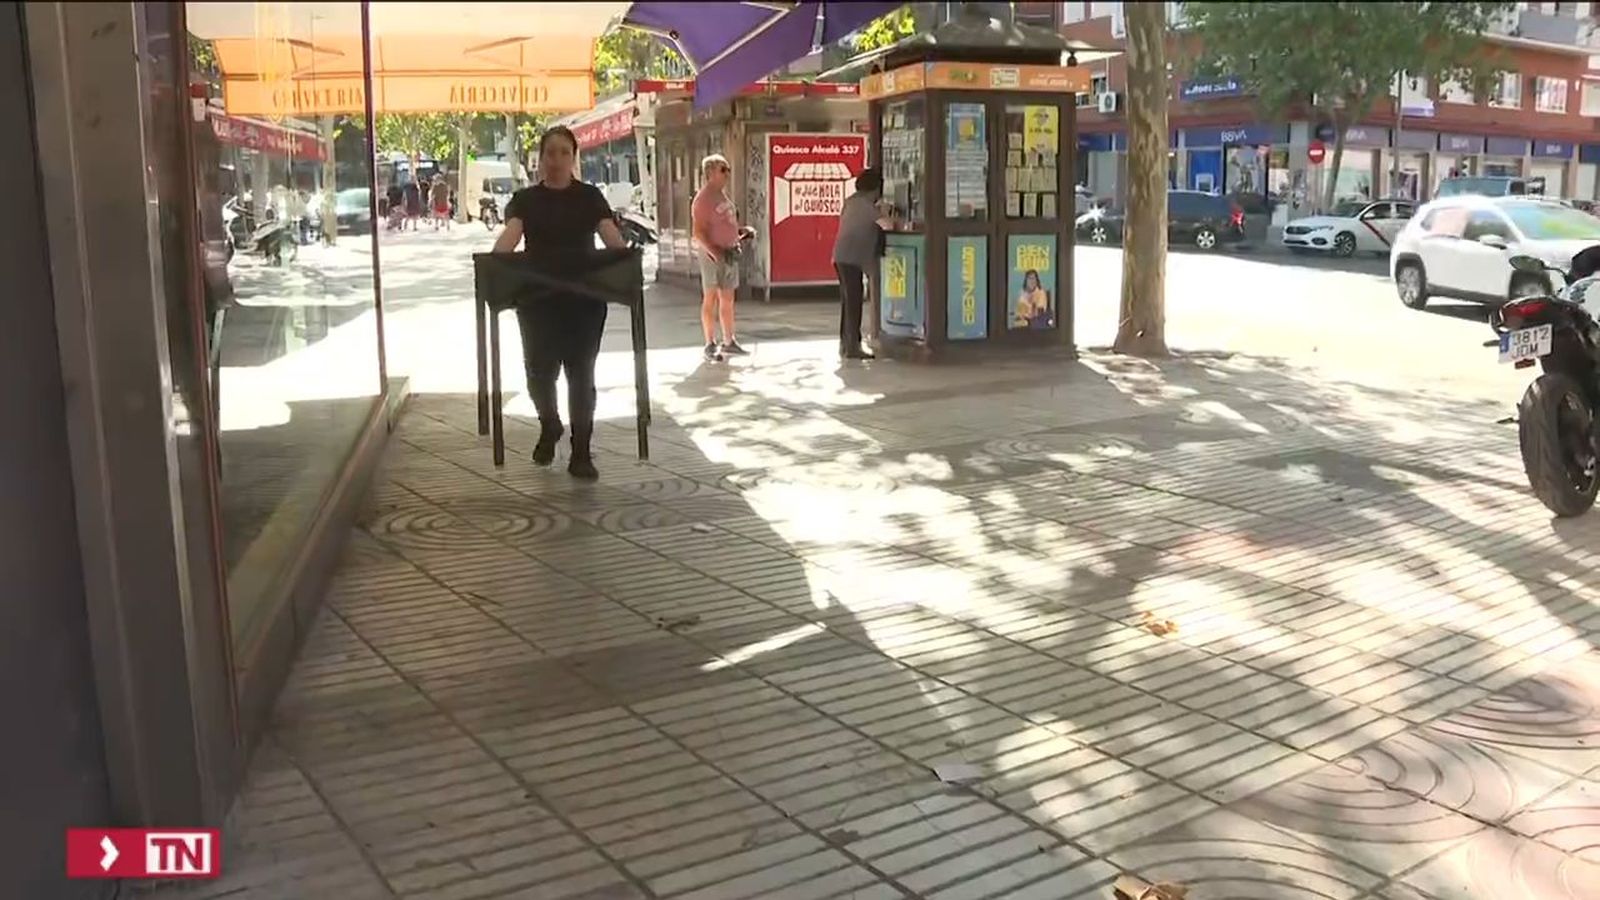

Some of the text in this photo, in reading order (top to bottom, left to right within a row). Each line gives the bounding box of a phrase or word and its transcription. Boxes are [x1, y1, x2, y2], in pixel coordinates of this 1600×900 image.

[1221, 129, 1247, 142] BBVA
[772, 144, 810, 154] Quiosco
[841, 145, 860, 154] 337
